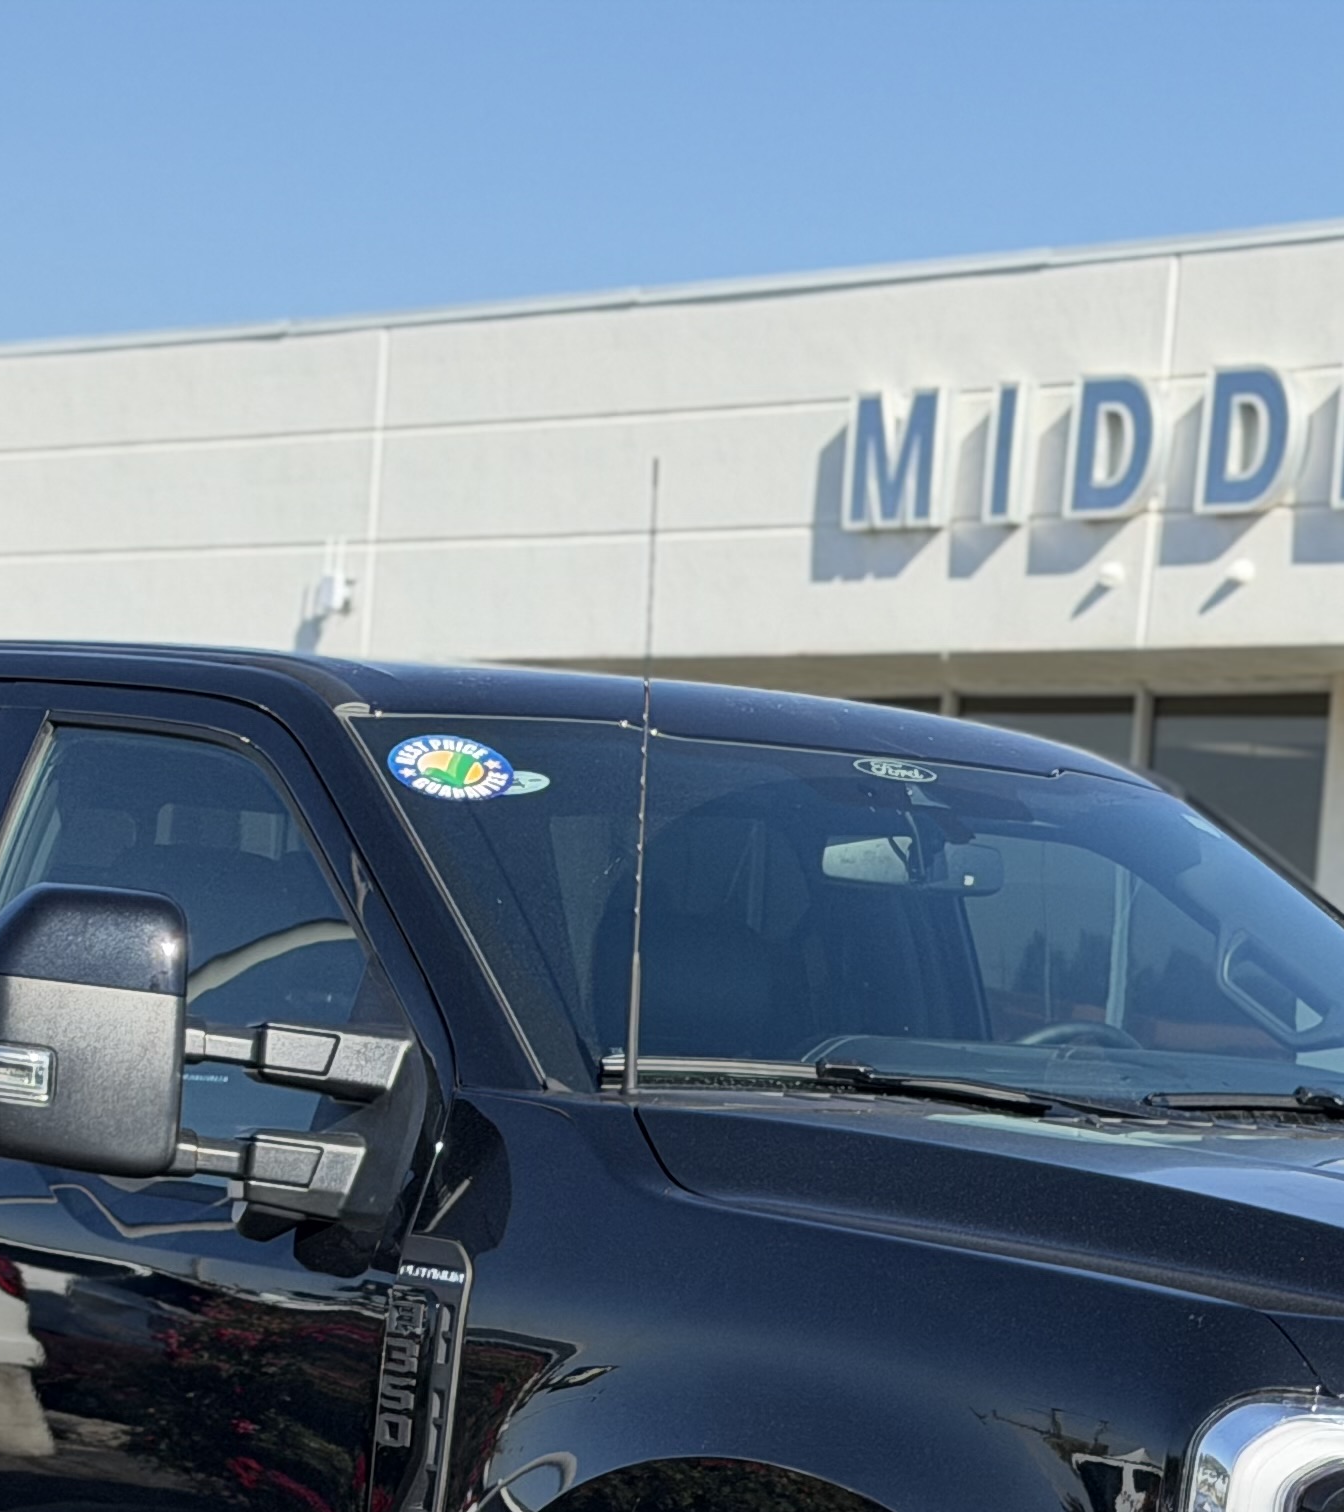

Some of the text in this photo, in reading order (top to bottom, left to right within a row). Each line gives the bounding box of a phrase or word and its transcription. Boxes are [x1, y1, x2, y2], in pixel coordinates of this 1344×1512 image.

[395, 739, 488, 765] BEST PRICE
[869, 760, 924, 779] Ford
[412, 771, 509, 799] GUARANTEE
